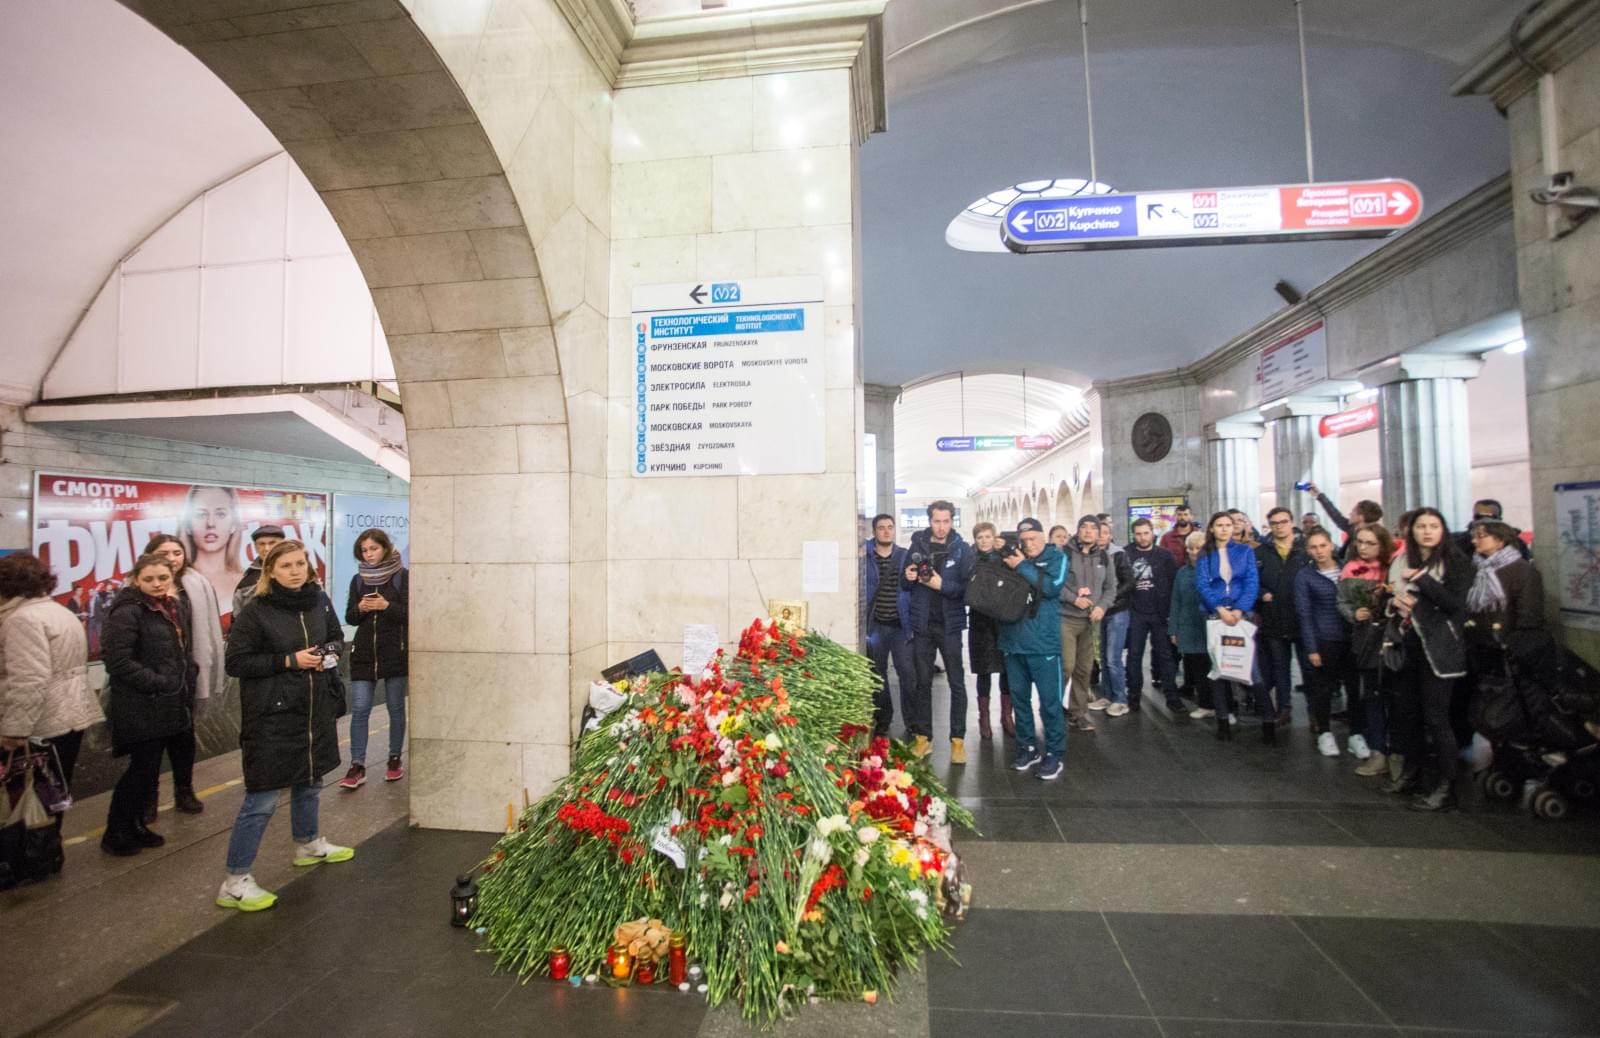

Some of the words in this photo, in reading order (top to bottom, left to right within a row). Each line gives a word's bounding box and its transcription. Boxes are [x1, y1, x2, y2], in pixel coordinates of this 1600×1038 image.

[1069, 205, 1123, 219] Купчино
[1069, 219, 1120, 232] Kupchino
[653, 312, 729, 327] ТЕХНОЛОГИЧЕСКИЙ
[653, 326, 694, 337] ИНСТИТУТ
[650, 340, 707, 352] ФРУНЗЕНСКАЯ
[650, 362, 702, 372] МОСКОВСКИЕ
[703, 360, 734, 370] ВОРОТА
[784, 357, 808, 366] VOROTA
[650, 382, 706, 392] ЭЛЕКТРОСИЛА
[650, 402, 670, 412] ПАРК
[672, 401, 706, 412] ПОБЕДЫ
[650, 422, 703, 432] МОСКОВСКАЯ
[650, 441, 691, 452] ЗВЁЗДНАЯ
[650, 462, 687, 472] КУПЧИНО
[52, 479, 139, 499] СМОТРИ
